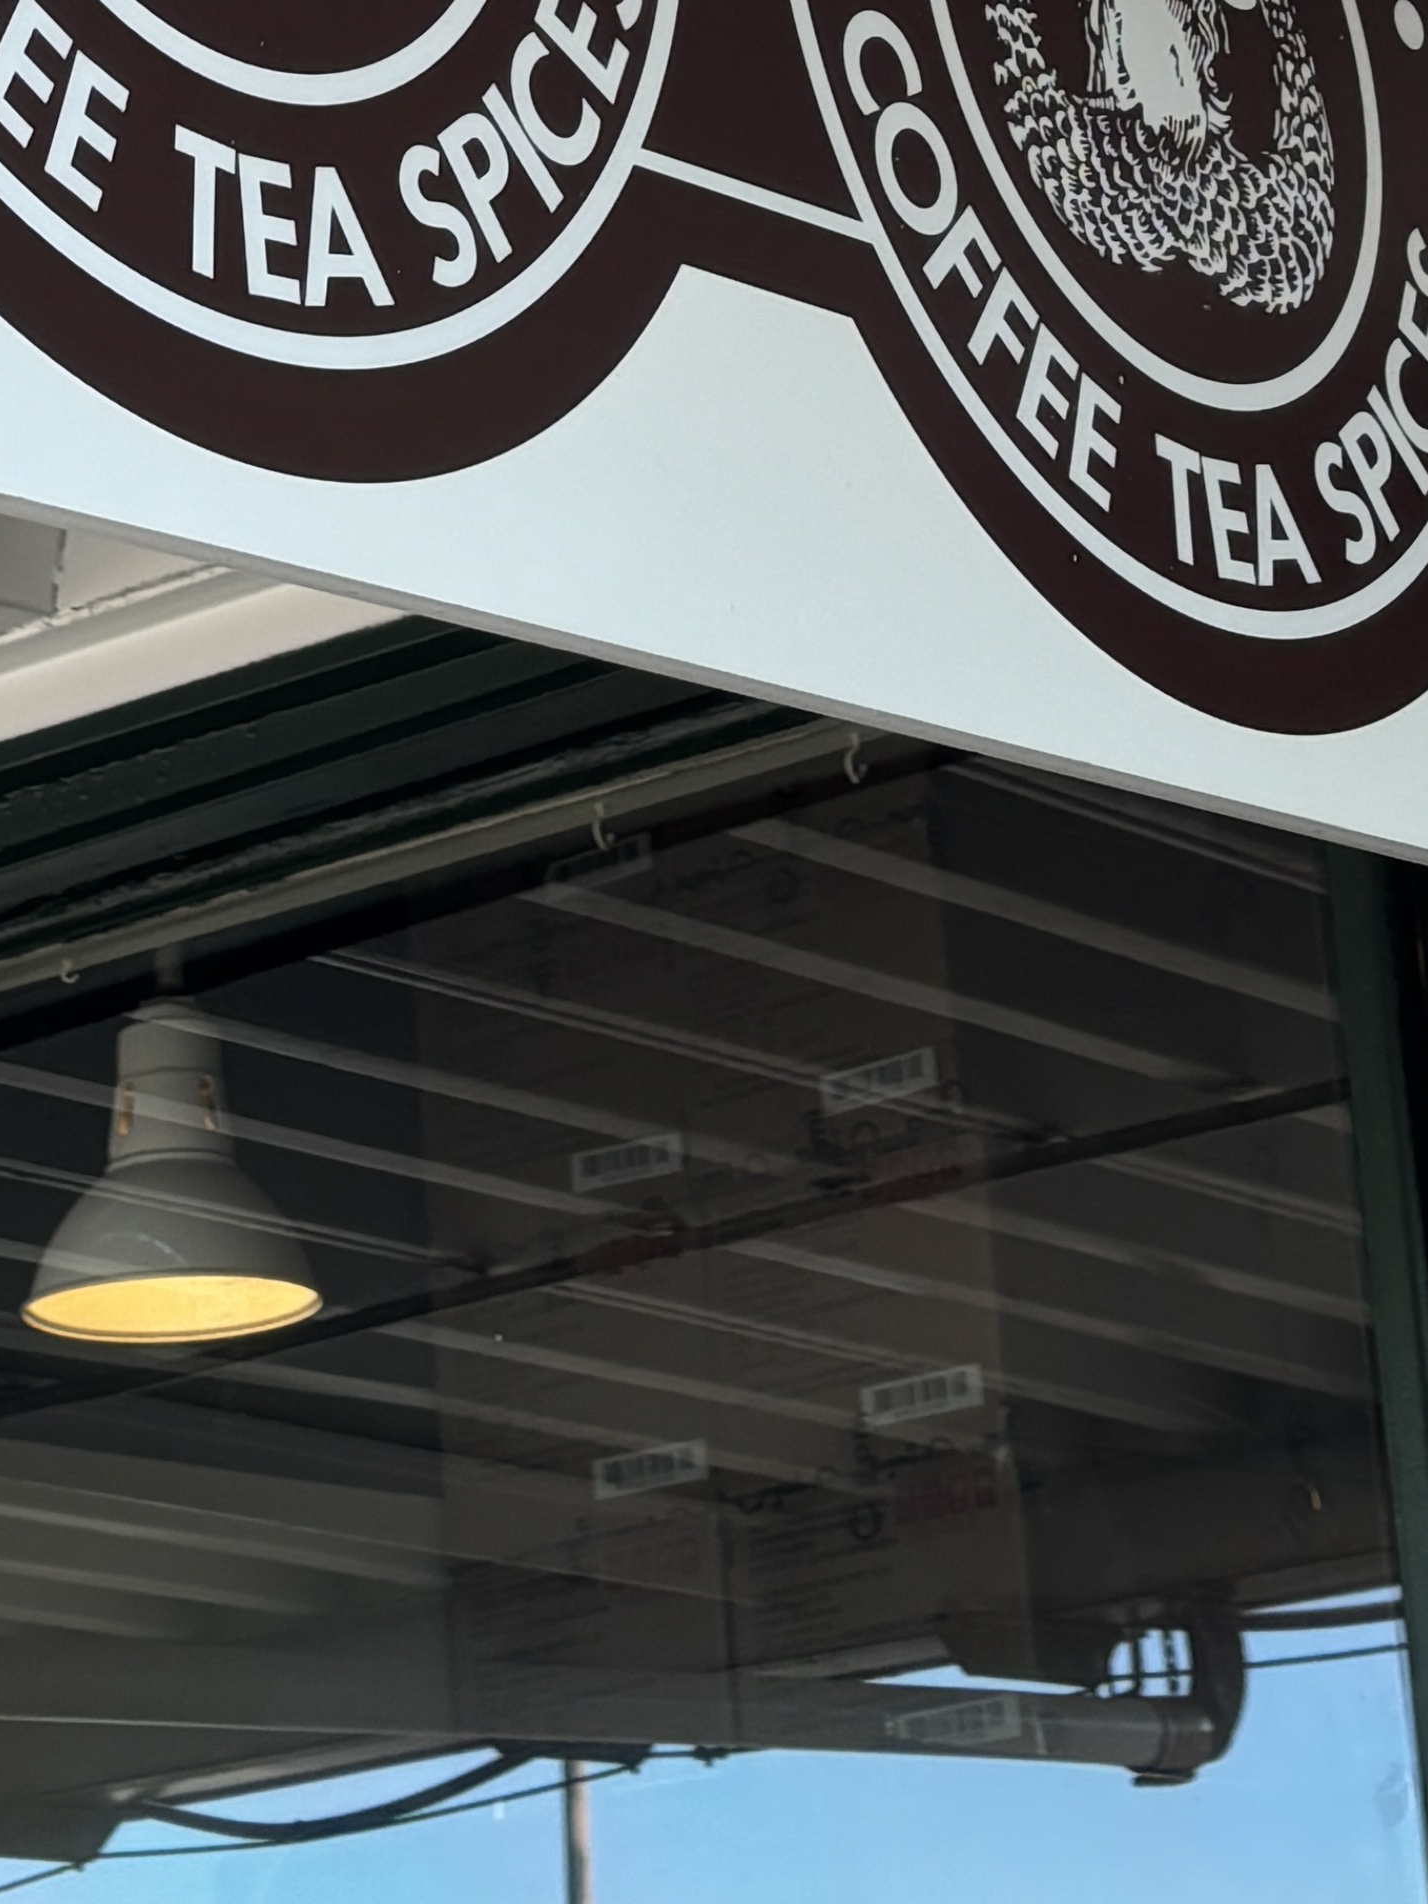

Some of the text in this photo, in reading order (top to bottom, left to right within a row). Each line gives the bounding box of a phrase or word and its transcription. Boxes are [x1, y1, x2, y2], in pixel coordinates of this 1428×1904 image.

[174, 123, 395, 307] TEA
[842, 9, 1122, 513] COFFEE
[1154, 433, 1322, 587] TEA
